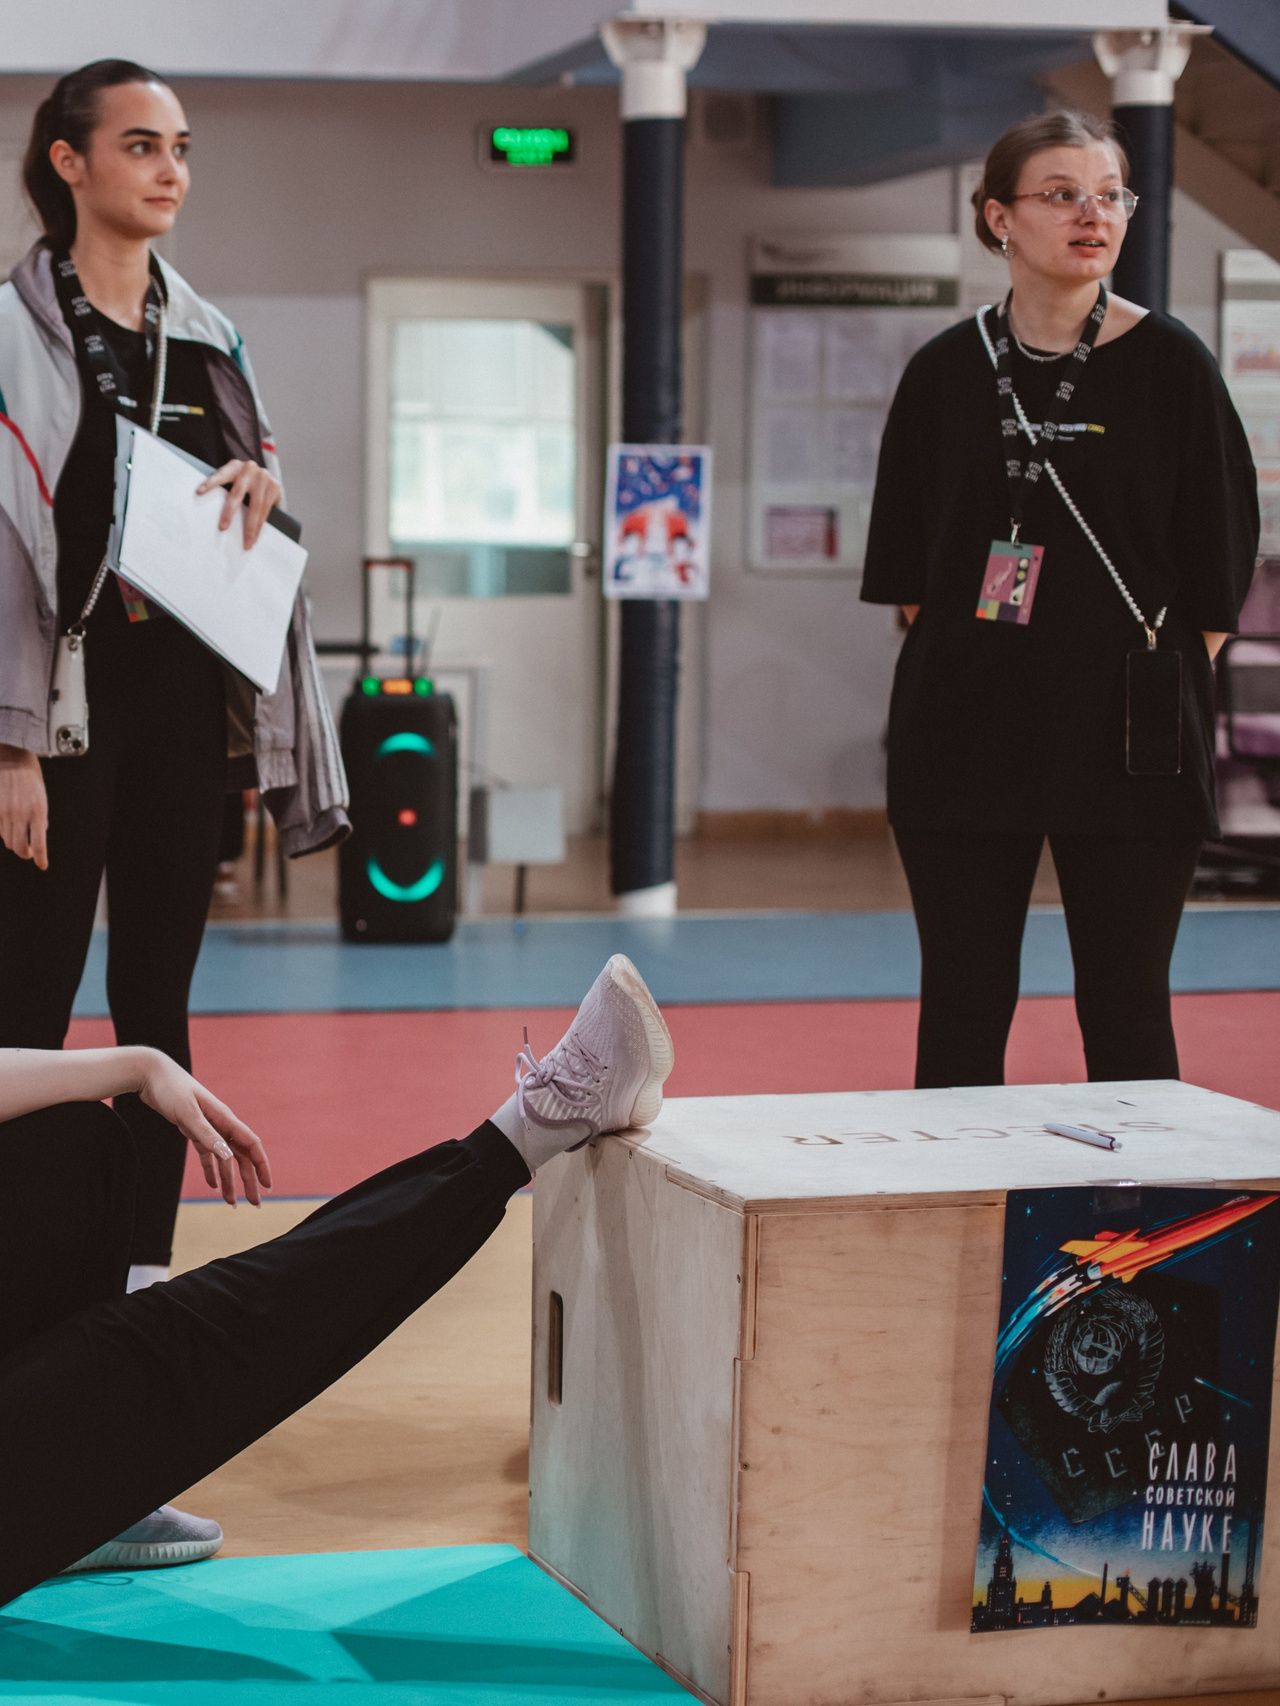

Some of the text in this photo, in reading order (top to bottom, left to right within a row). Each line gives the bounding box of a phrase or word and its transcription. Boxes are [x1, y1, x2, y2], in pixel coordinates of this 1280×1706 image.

[1148, 1441, 1237, 1483] СЛАВА
[1145, 1485, 1236, 1508] СОВЕТСКОЙ
[1141, 1510, 1233, 1554] НАУКЕ
